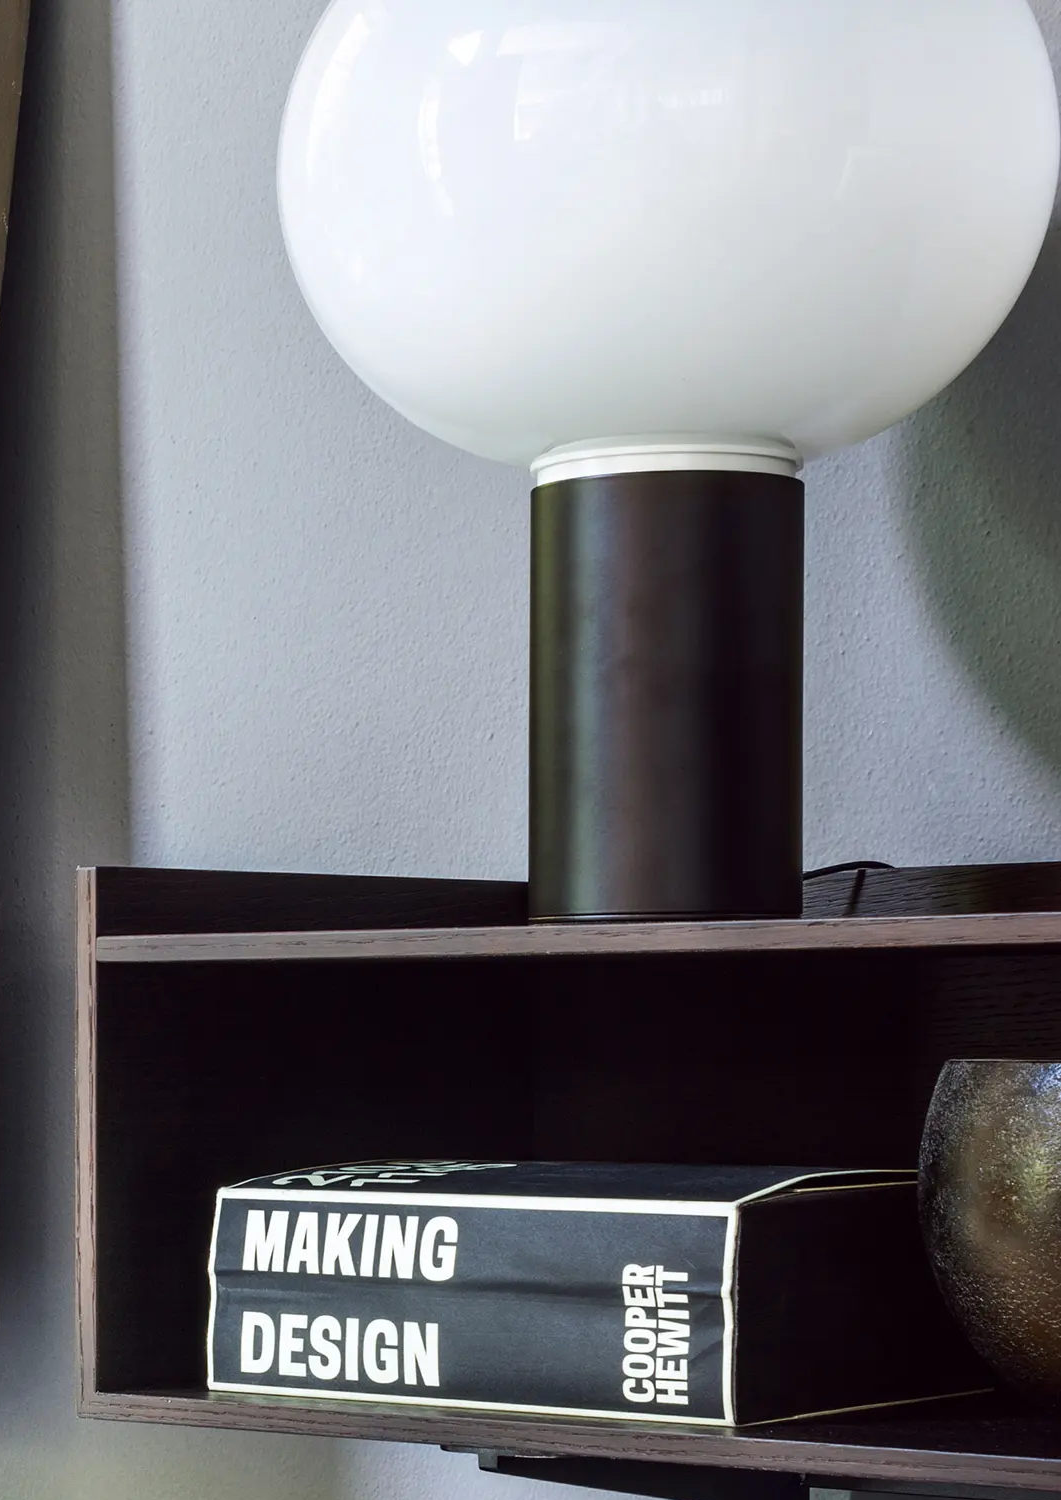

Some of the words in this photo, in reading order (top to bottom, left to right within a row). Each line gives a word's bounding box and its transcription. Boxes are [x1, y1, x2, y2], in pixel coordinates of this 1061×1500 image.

[241, 1209, 459, 1282] MAKING
[240, 1311, 440, 1387] DESIGN
[622, 1262, 659, 1403] COOPER
[654, 1265, 689, 1405] HEWITT
